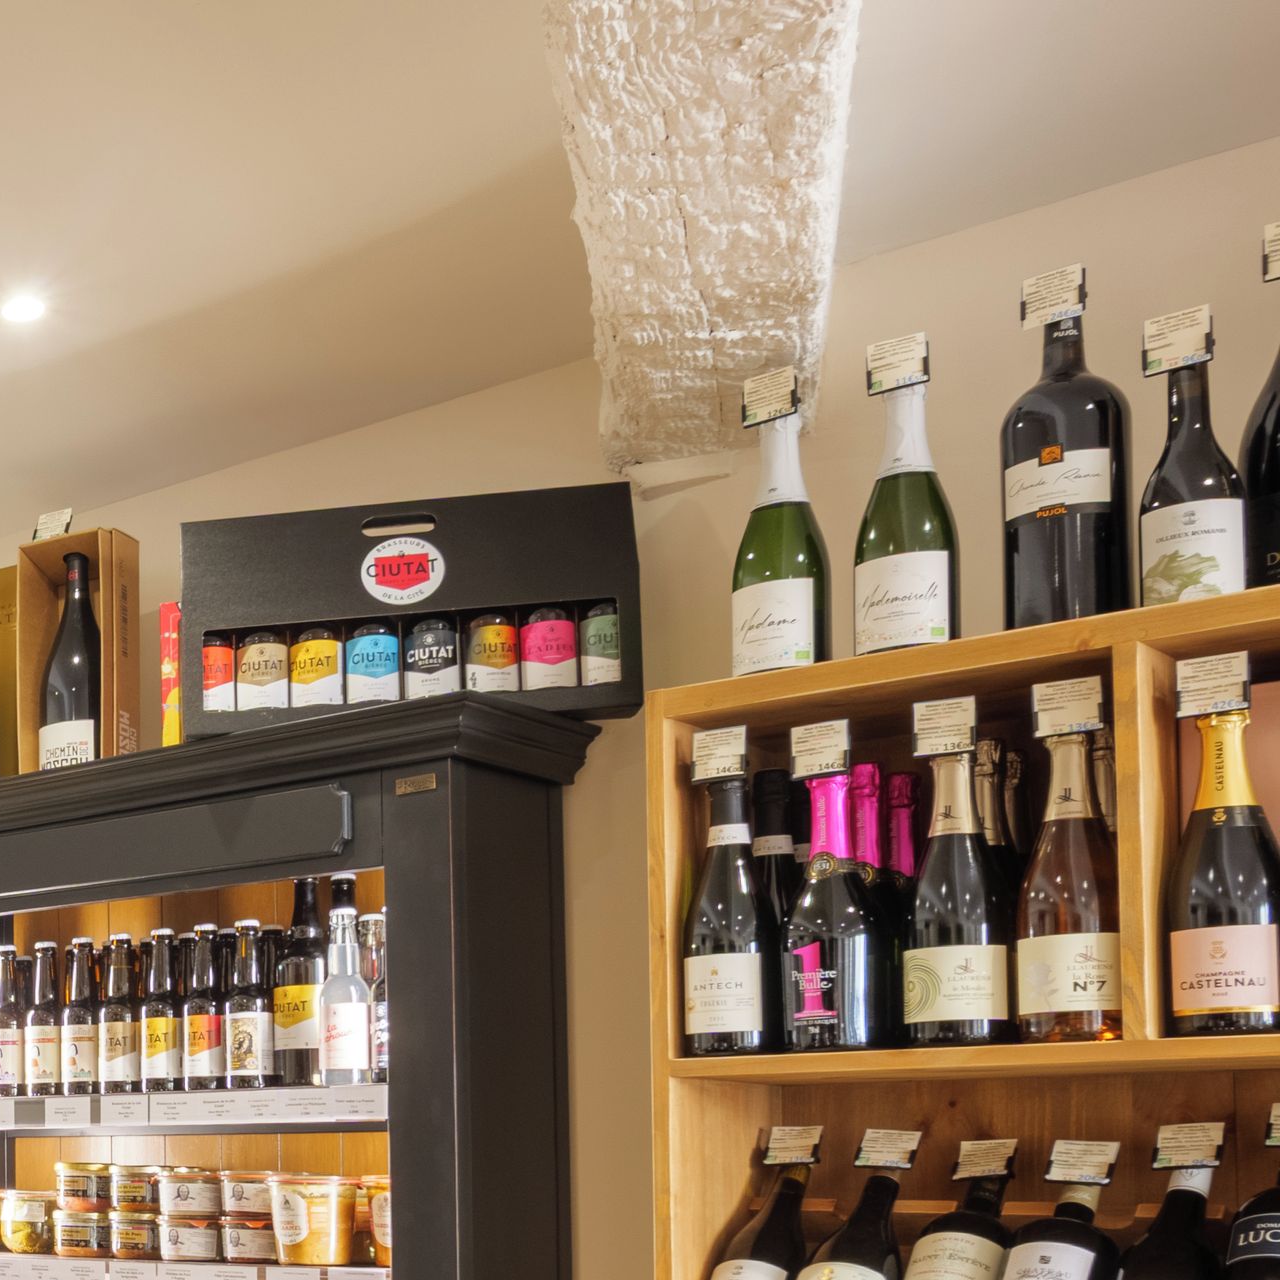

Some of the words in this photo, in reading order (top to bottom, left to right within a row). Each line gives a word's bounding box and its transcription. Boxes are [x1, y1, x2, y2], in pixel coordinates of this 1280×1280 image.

[1052, 328, 1080, 338] PUJOL
[1036, 506, 1068, 519] PUJOL
[366, 557, 438, 578] CIUTAT
[407, 645, 453, 663] CIUTAT
[474, 643, 516, 656] CIUTAT
[290, 656, 332, 672] CIUTAT
[351, 652, 397, 665] CIUTAT
[240, 659, 284, 674] CIUTAT
[45, 745, 79, 760] CHEMIN
[1215, 740, 1224, 792] CASTELNAU
[792, 968, 837, 982] Première
[1195, 970, 1246, 979] CHAMPAGNE
[693, 981, 743, 992] ANTECH
[799, 979, 832, 991] Bulle
[1073, 980, 1107, 992] N°7
[1180, 977, 1266, 991] CASTELNAU
